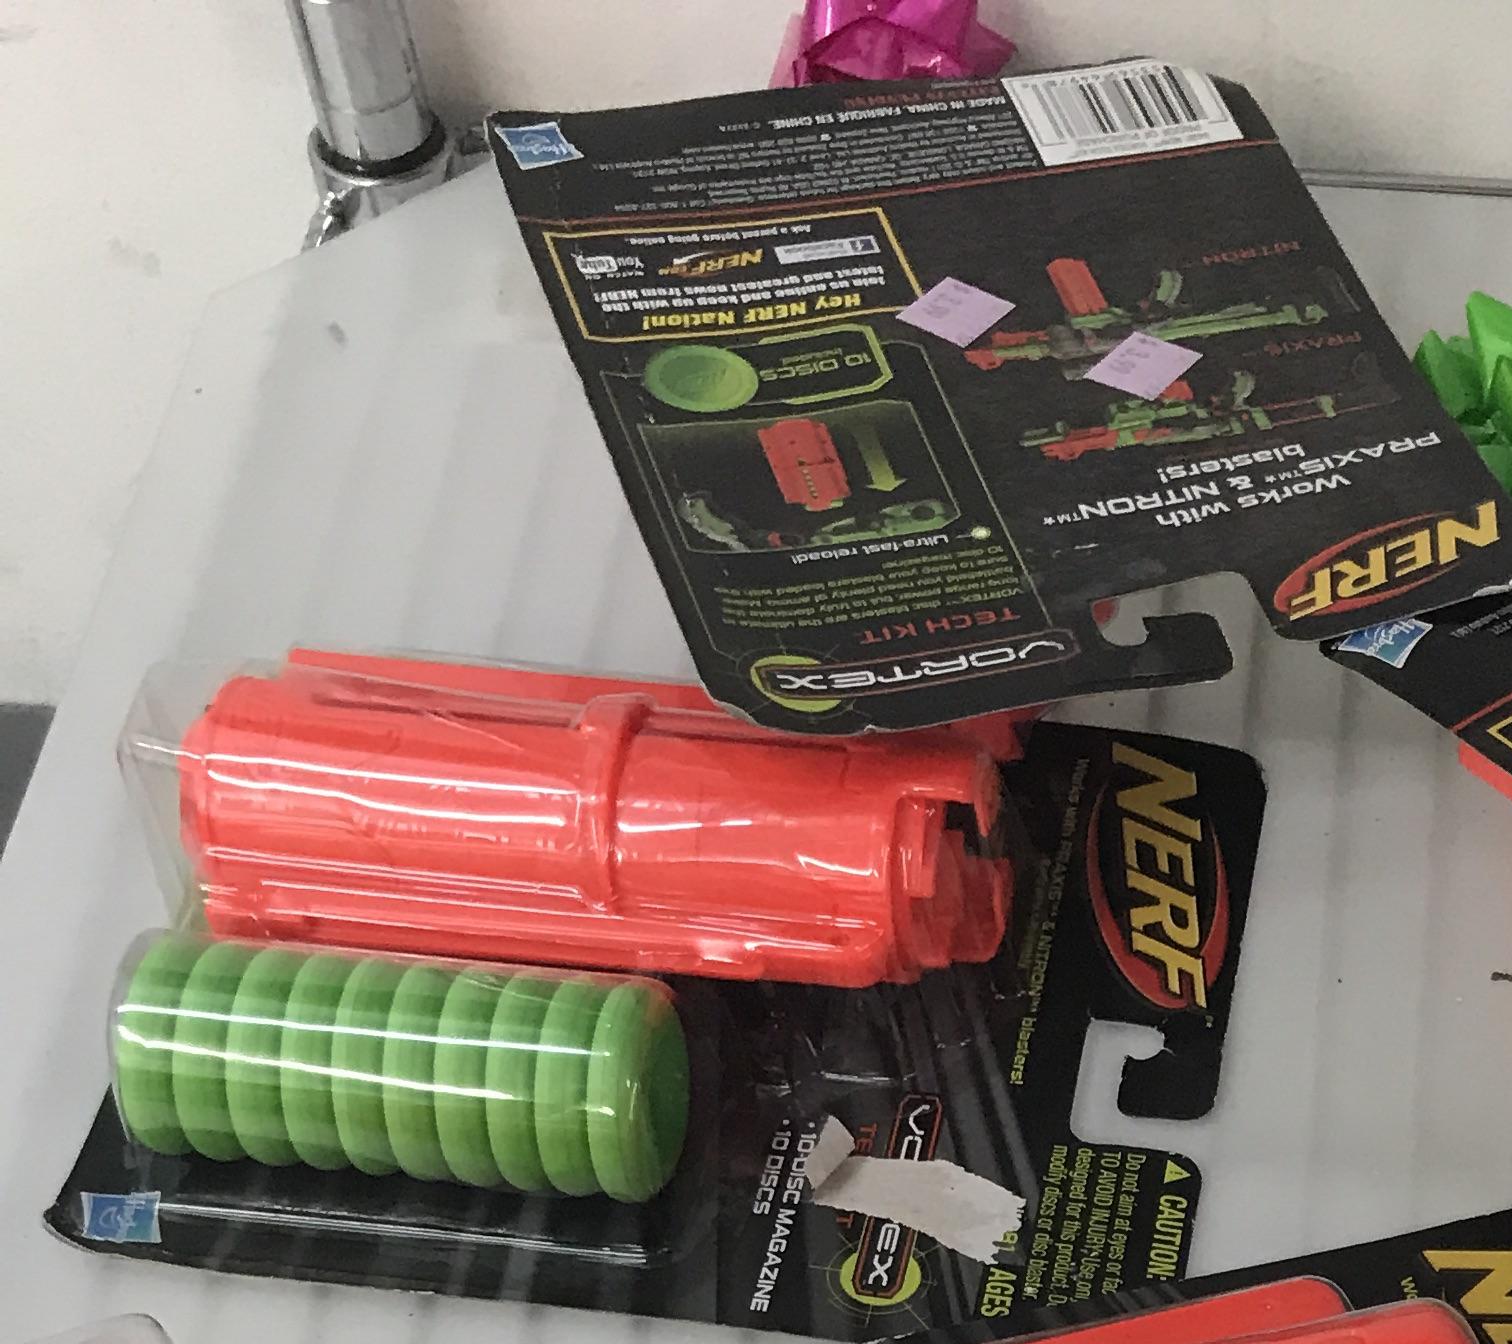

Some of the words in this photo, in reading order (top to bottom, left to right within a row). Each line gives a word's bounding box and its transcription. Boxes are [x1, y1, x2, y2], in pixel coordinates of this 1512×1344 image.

[742, 299, 806, 324] NERF
[813, 289, 860, 311] Hey
[641, 307, 736, 330] Nation!
[1157, 441, 1304, 484] blasters!
[1225, 472, 1251, 493] &
[1236, 470, 1351, 510] Works
[1155, 498, 1230, 529] with
[790, 544, 857, 565] reload!
[860, 532, 948, 555] Ultra-fast
[1289, 501, 1498, 619] NERF
[855, 621, 915, 644] KIT
[919, 605, 1020, 634] TECH
[776, 640, 1065, 693] VORTEX
[1066, 757, 1089, 801] Works
[1059, 805, 1079, 837] with
[1112, 742, 1205, 1008] NERF
[1008, 1016, 1035, 1086] blasters!
[771, 1128, 791, 1151] 10
[1041, 1143, 1069, 1185] modify
[1099, 1149, 1121, 1168] TO
[1124, 1152, 1145, 1171] Do
[752, 1153, 785, 1216] DISCS
[1066, 1146, 1095, 1200] designed
[1121, 1171, 1142, 1193] not
[1037, 1185, 1061, 1217] discs
[1093, 1169, 1117, 1206] AVOID
[1065, 1201, 1085, 1218] for
[1116, 1193, 1138, 1217] aim
[1036, 1218, 1052, 1230] or
[1059, 1219, 1081, 1242] this
[1113, 1218, 1132, 1231] at
[1146, 1193, 1187, 1281] CAUTION:
[1029, 1231, 1052, 1257] disc
[1104, 1232, 1127, 1259] eyes
[748, 1208, 795, 1312] MAGAZINE
[1049, 1242, 1076, 1292] product.
[1077, 1256, 1100, 1279] Use
[1106, 1261, 1123, 1276] or
[979, 1266, 1016, 1319] AGES
[1021, 1257, 1047, 1302] blaster.
